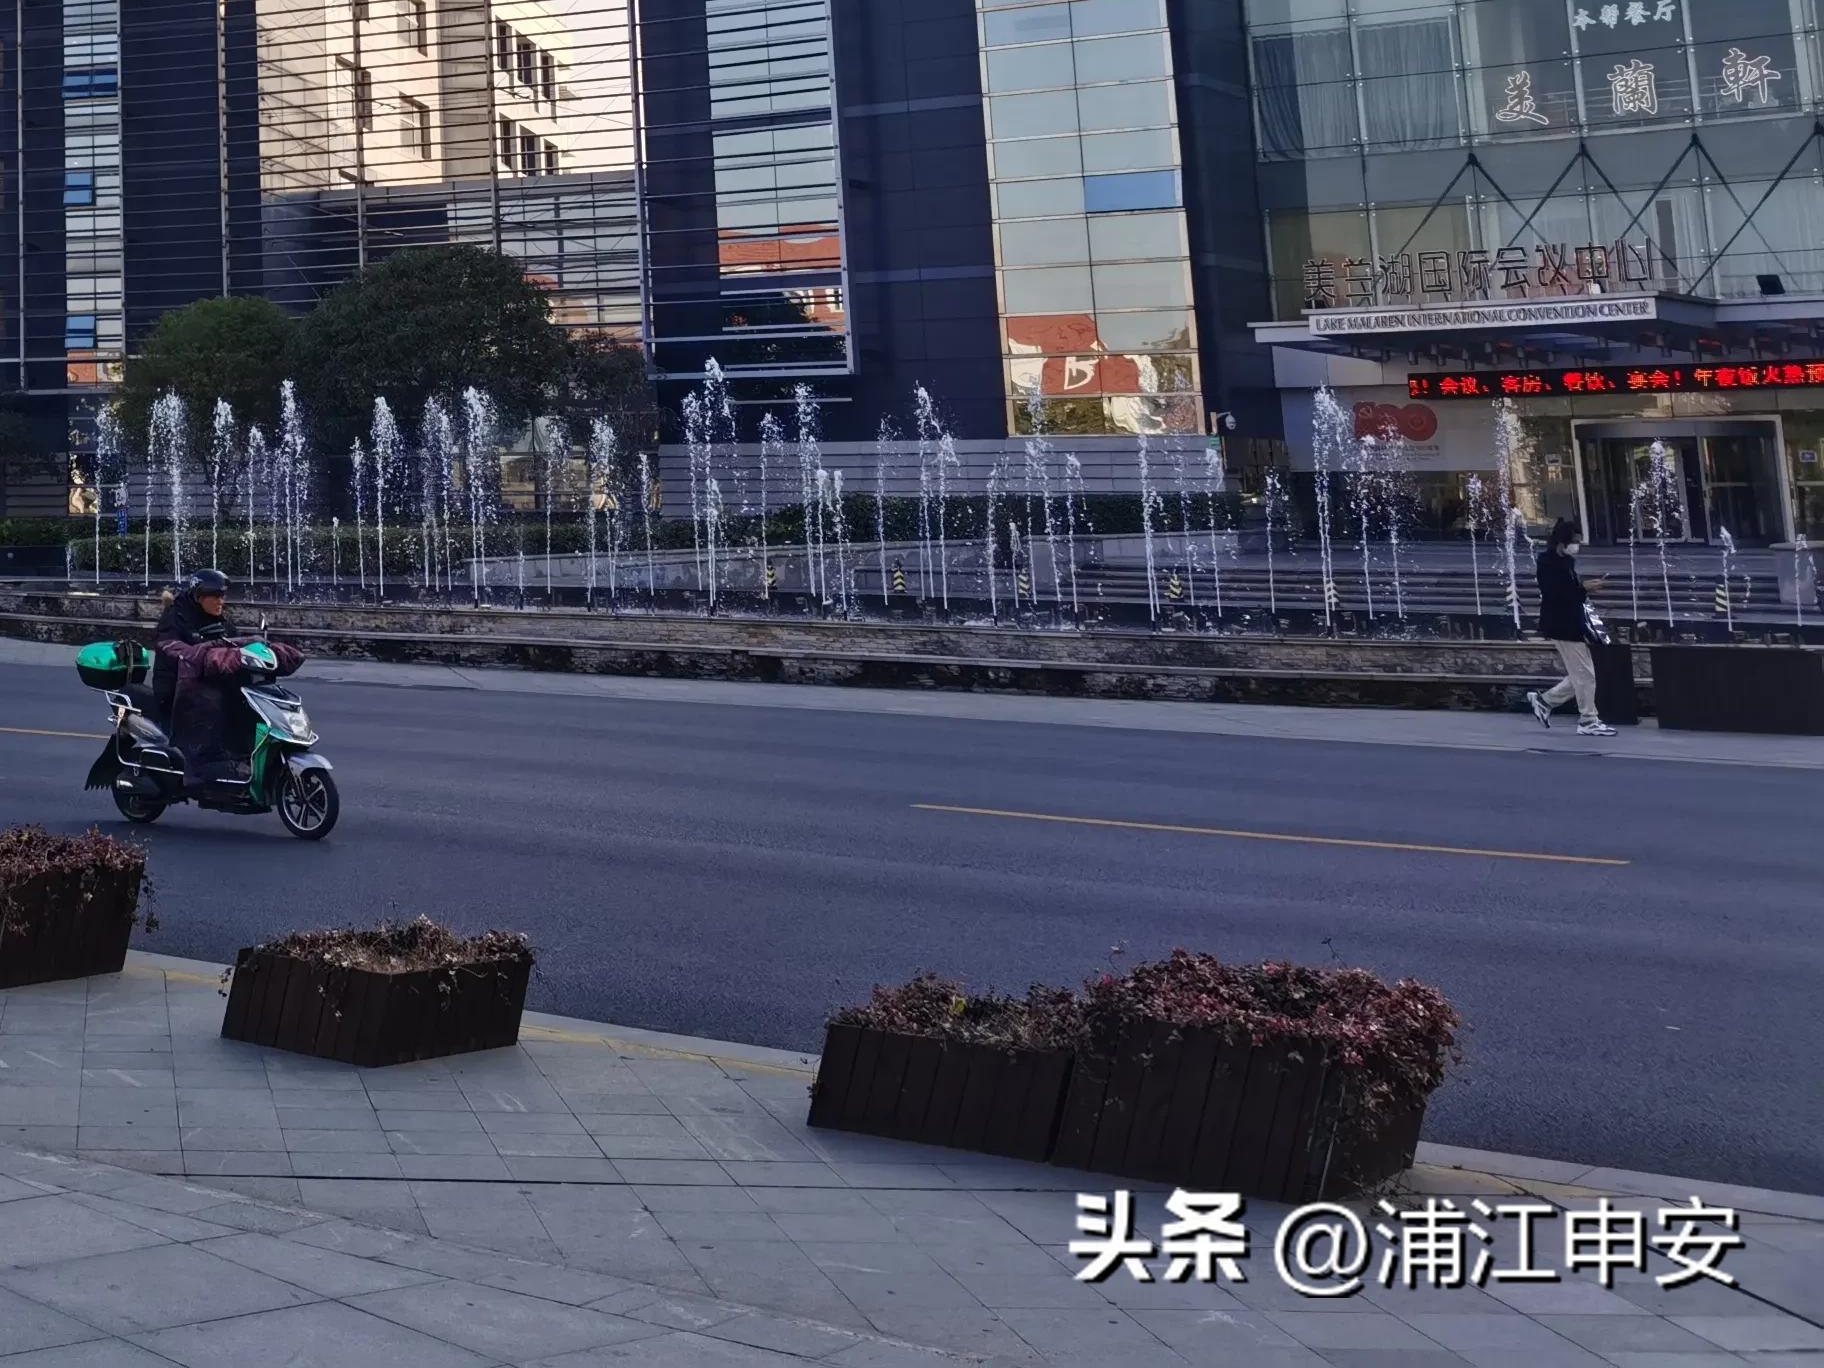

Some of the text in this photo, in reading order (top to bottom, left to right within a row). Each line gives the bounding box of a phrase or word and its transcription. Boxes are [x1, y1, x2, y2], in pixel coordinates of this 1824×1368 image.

[1302, 237, 1653, 301] 美兰湖国际会议中心
[1316, 317, 1345, 331] LAKE
[1407, 309, 1506, 327] INTERNATIONAL
[1507, 304, 1598, 322] CONVENTION
[1599, 301, 1649, 317] CENTER
